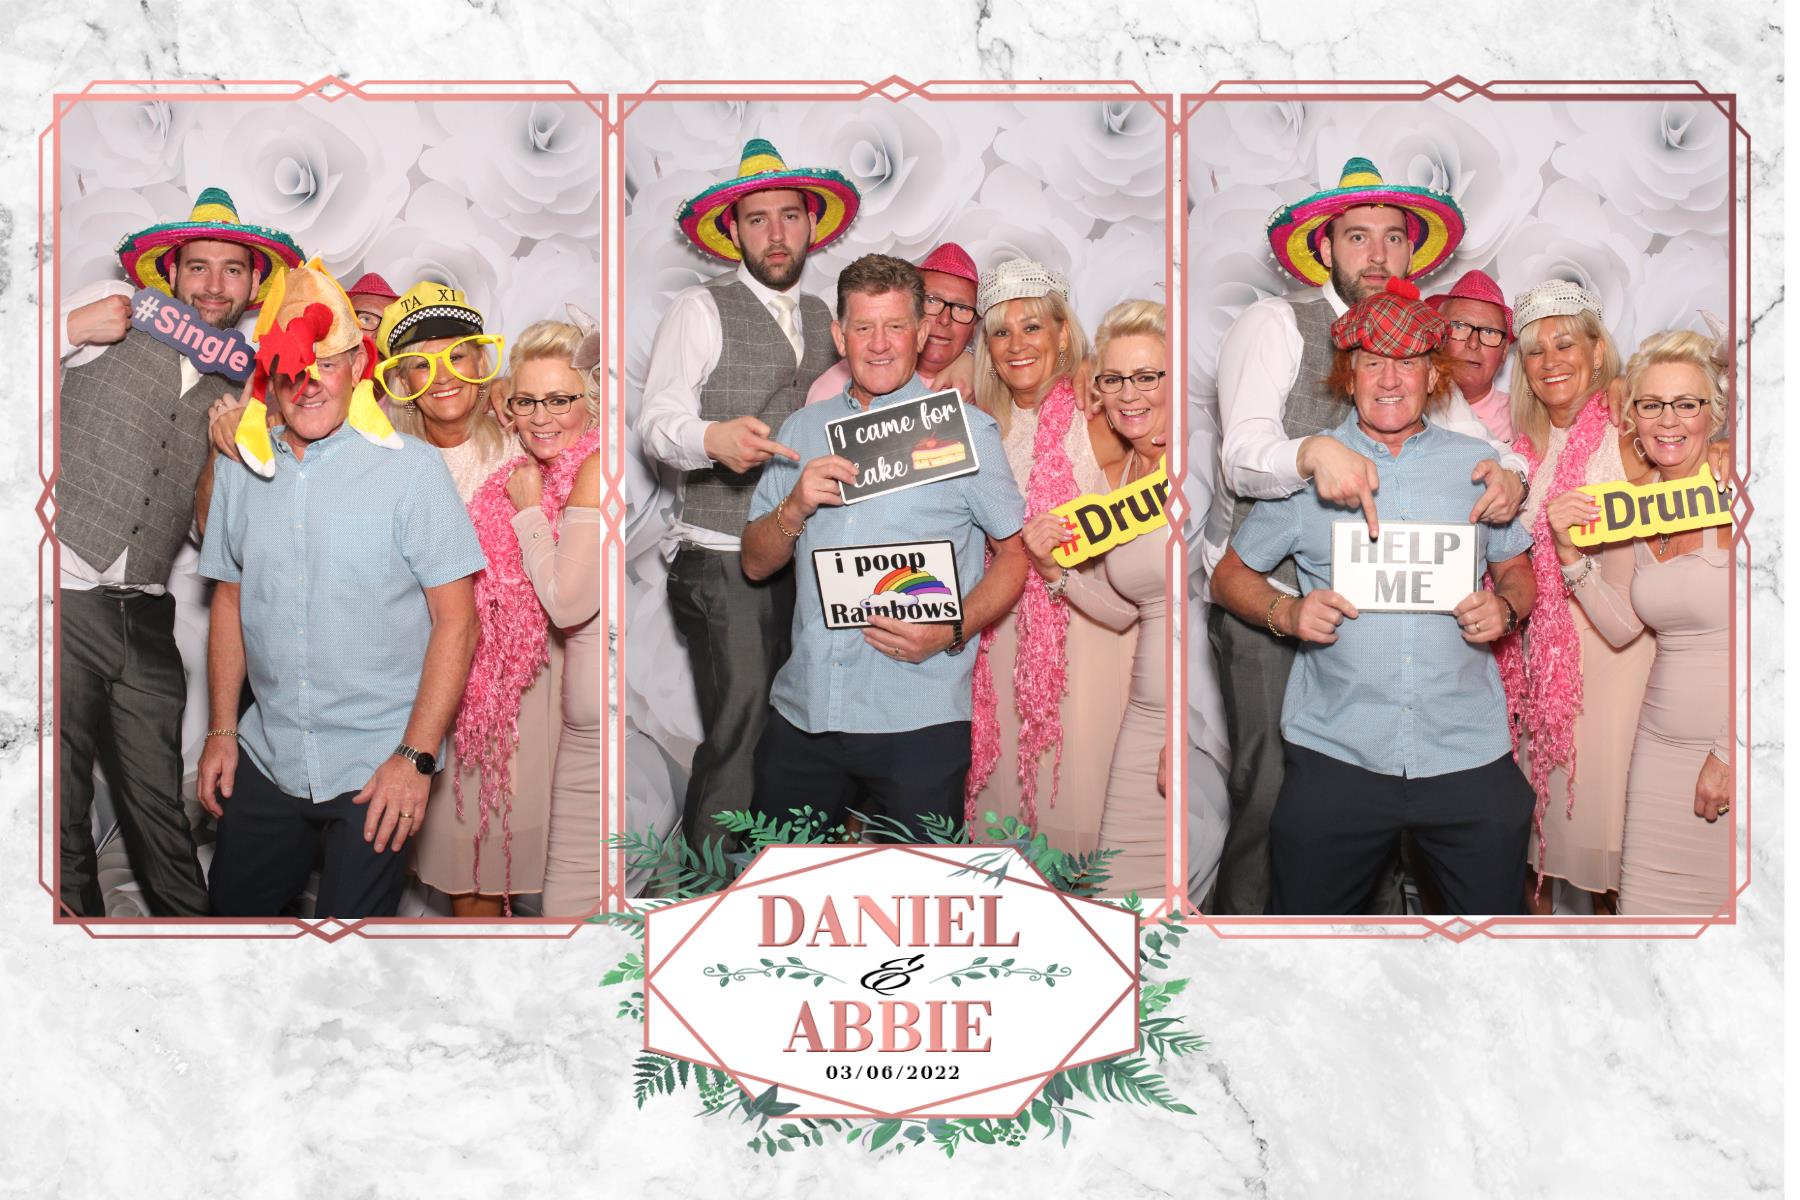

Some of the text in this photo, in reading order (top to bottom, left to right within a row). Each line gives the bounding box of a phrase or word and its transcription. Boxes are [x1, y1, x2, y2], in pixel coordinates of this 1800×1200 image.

[134, 295, 249, 372] #Single
[834, 402, 957, 449] I came for
[834, 551, 926, 577] i poop
[1350, 530, 1461, 565] HELP
[1375, 570, 1435, 604] ME
[830, 600, 958, 624] Rainbows
